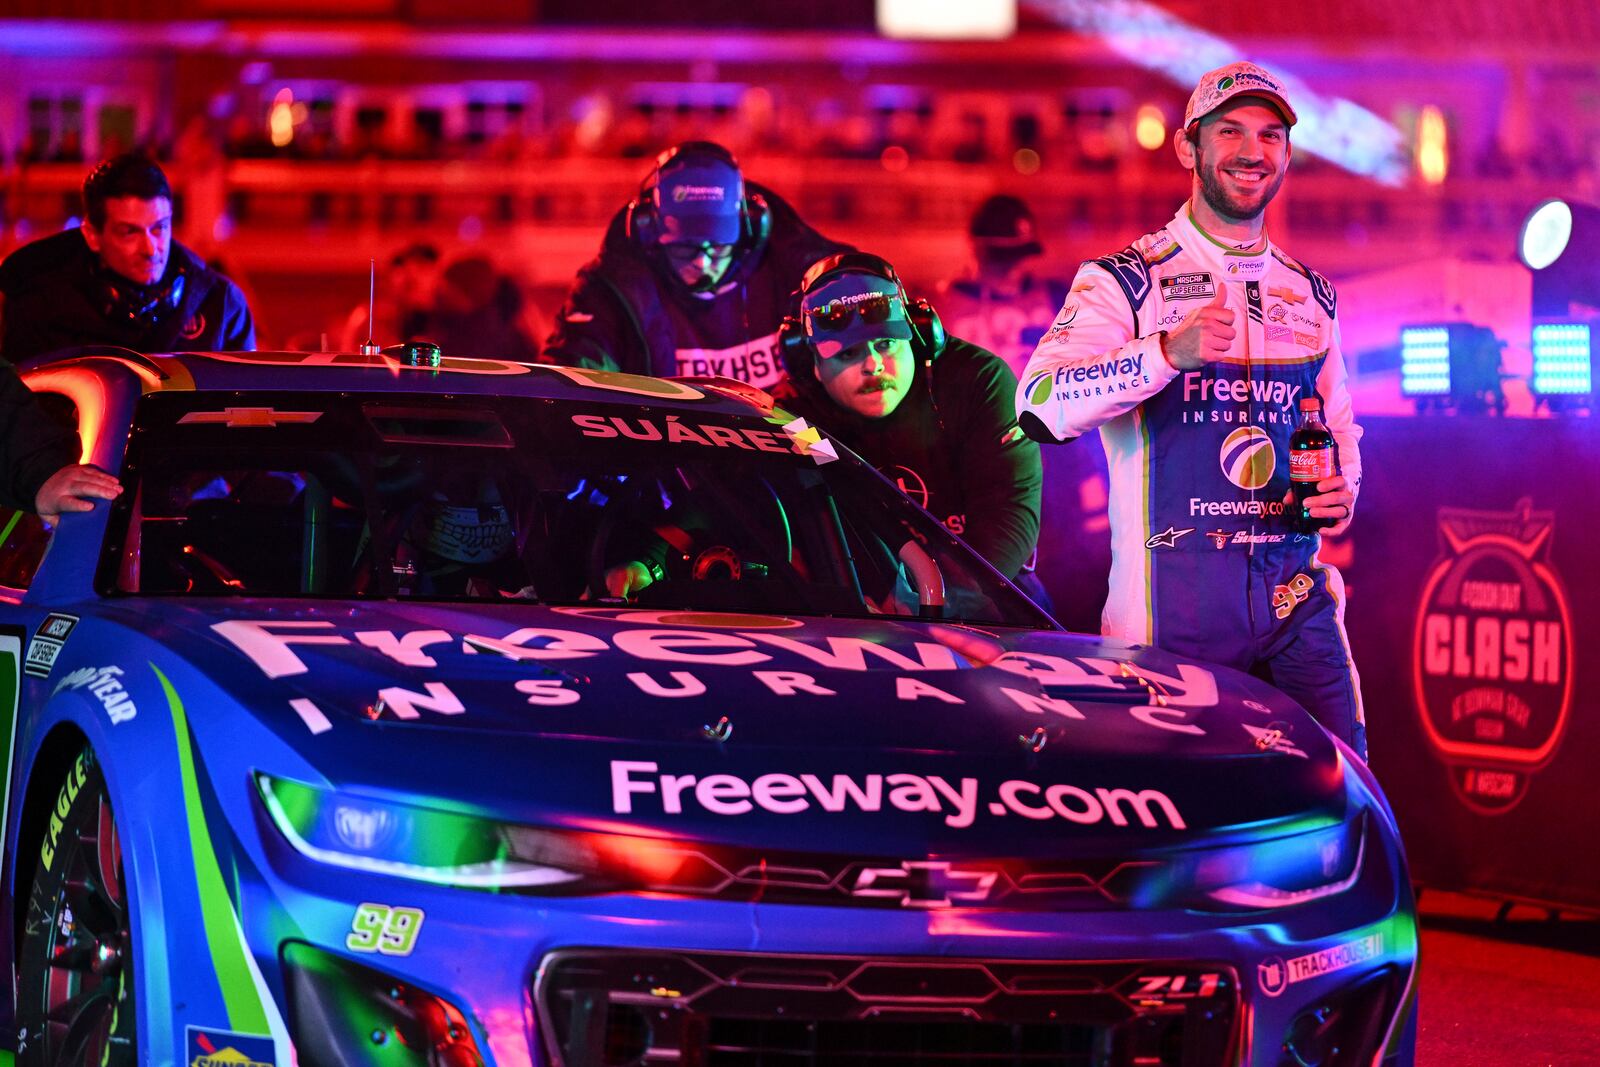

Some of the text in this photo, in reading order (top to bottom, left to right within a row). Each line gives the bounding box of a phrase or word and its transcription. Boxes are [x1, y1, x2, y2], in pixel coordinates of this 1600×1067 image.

[1235, 73, 1278, 90] Freeway
[1238, 261, 1265, 271] Freeway
[1170, 285, 1206, 295] CUP SERIES
[1177, 275, 1204, 284] NASCAR
[841, 292, 883, 305] Freeway
[1157, 314, 1185, 325] JOCK
[1056, 353, 1144, 384] Freeway
[1056, 376, 1150, 400] INSURANCE
[1183, 371, 1301, 412] Freeway
[1183, 411, 1292, 425] INSURANCE
[1190, 498, 1285, 519] Freeway.co
[1231, 531, 1286, 545] Suárez
[1272, 573, 1315, 620] 99
[1424, 614, 1561, 684] CLASH
[209, 619, 1219, 707] Freeway
[289, 670, 1308, 758] INSURANCE
[610, 760, 1187, 830] Freeway.com
[41, 753, 87, 872] EAGLE
[346, 902, 425, 957] 99
[1292, 939, 1371, 979] TRACKHOUSE
[1129, 974, 1219, 999] ZL1
[194, 1057, 274, 1067] SUN
